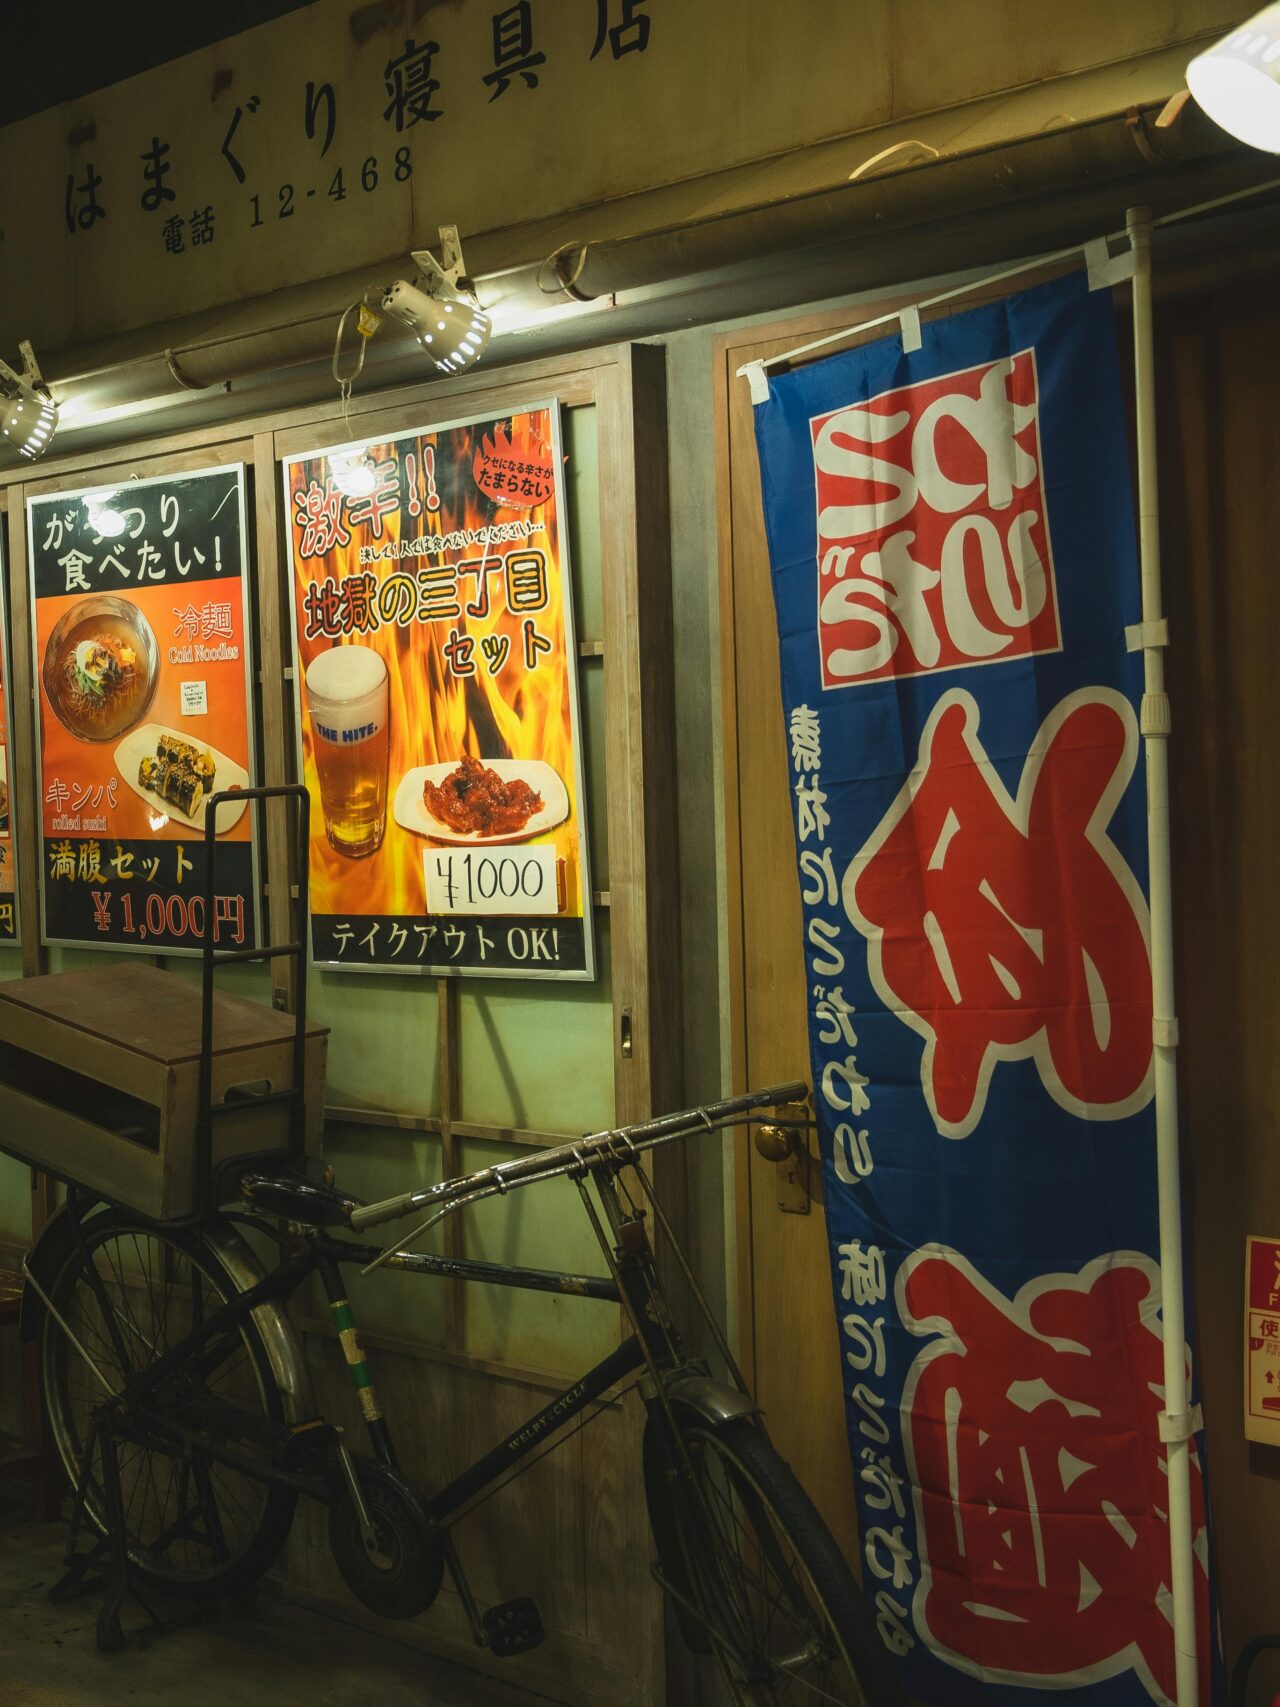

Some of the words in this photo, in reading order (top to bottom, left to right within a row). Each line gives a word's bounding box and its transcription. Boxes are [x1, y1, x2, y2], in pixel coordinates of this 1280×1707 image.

[64, 0, 652, 233] はまぐり寝具店
[161, 207, 216, 255] 電話
[248, 146, 413, 228] 12-468
[479, 469, 551, 498] たまらない
[482, 454, 554, 480] クセになる辛さが
[42, 493, 180, 551] がつり
[57, 535, 222, 592] 食べたい!
[305, 551, 549, 639] 地獄の三丁目
[172, 601, 234, 641] 冷麺
[168, 645, 193, 664] Cold
[195, 642, 239, 662] Noodles
[444, 619, 552, 676] セット
[316, 722, 338, 743] THE
[46, 778, 117, 813] キンパ
[52, 815, 81, 831] rolled
[82, 815, 107, 831] sushi
[49, 839, 194, 885] 満腹セット
[436, 853, 544, 909] ¥1000
[332, 921, 496, 960] テイクアウト
[507, 926, 561, 961] OK!
